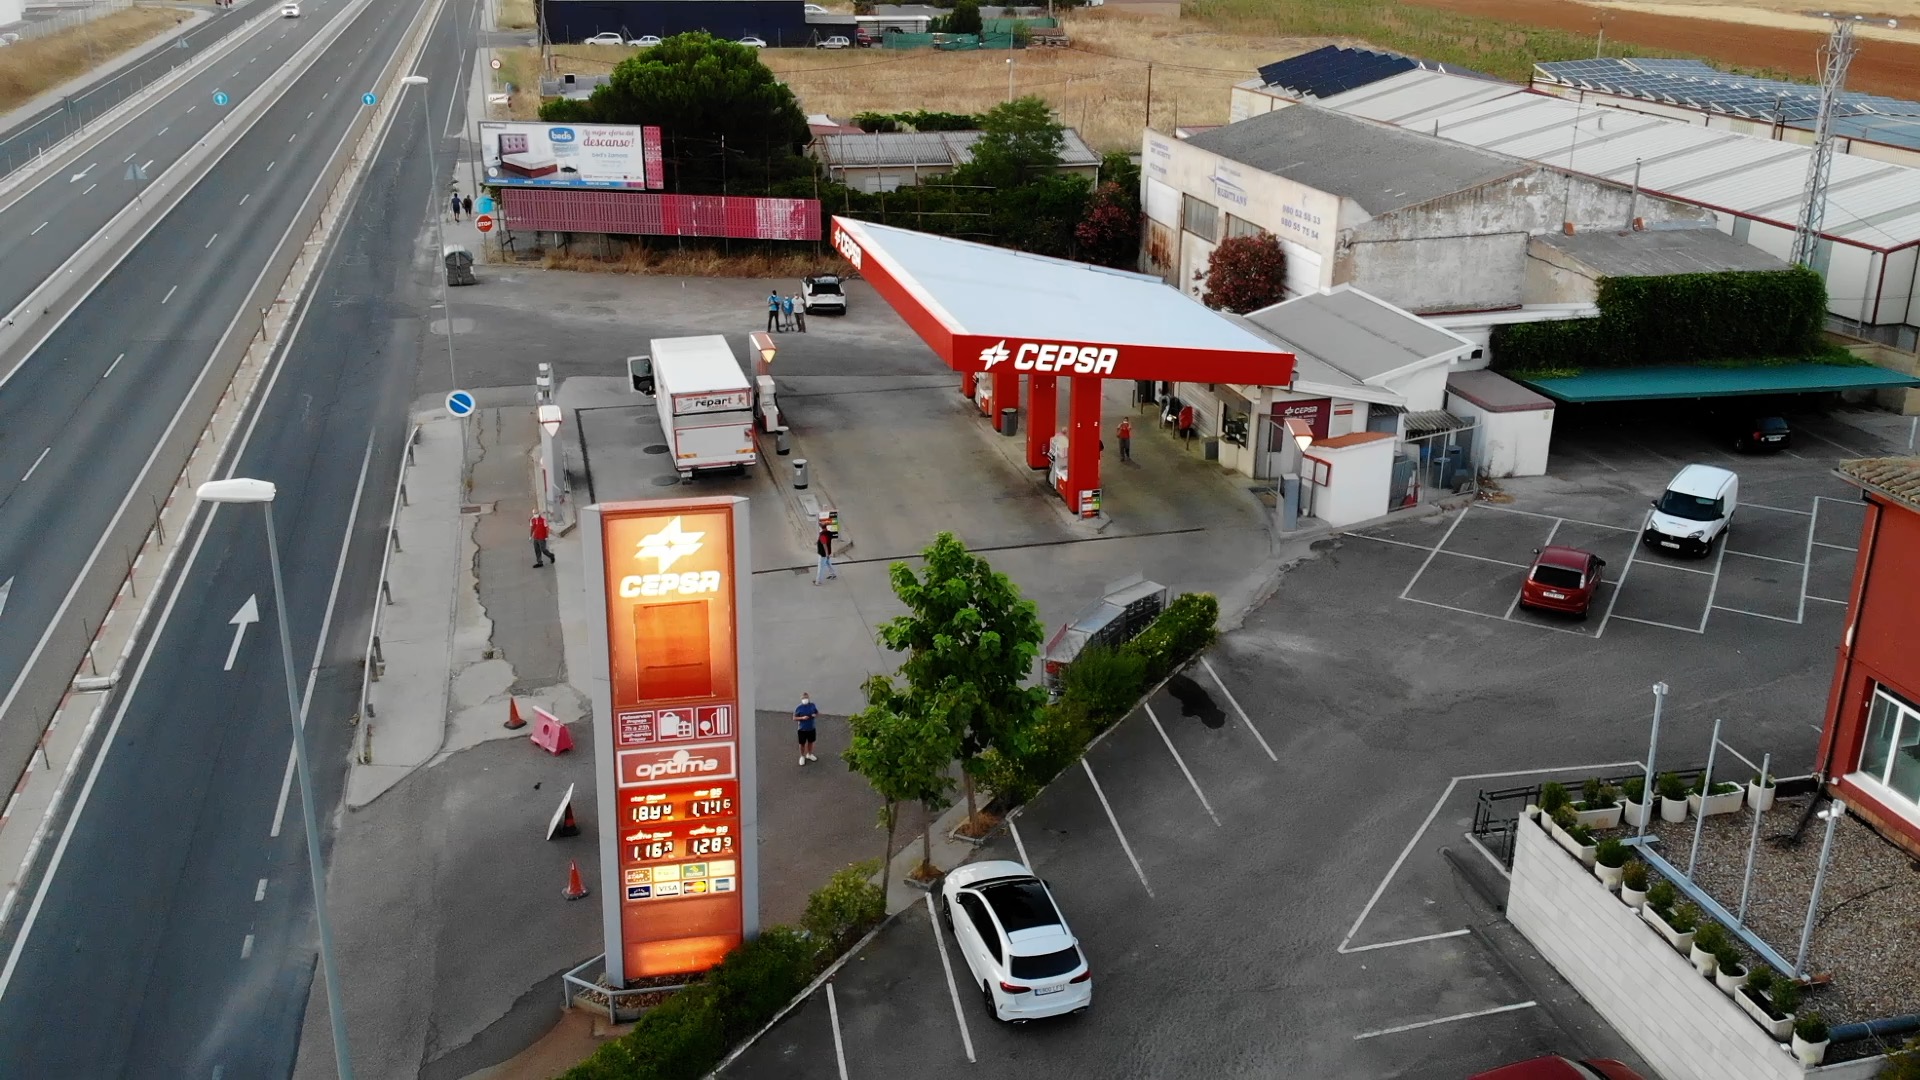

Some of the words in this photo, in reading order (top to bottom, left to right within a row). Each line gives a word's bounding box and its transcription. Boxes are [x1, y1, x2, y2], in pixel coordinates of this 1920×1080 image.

[1014, 343, 1119, 375] CEPSA
[1294, 406, 1318, 414] CEPSA
[619, 570, 721, 598] CEPSA
[636, 757, 718, 780] optima
